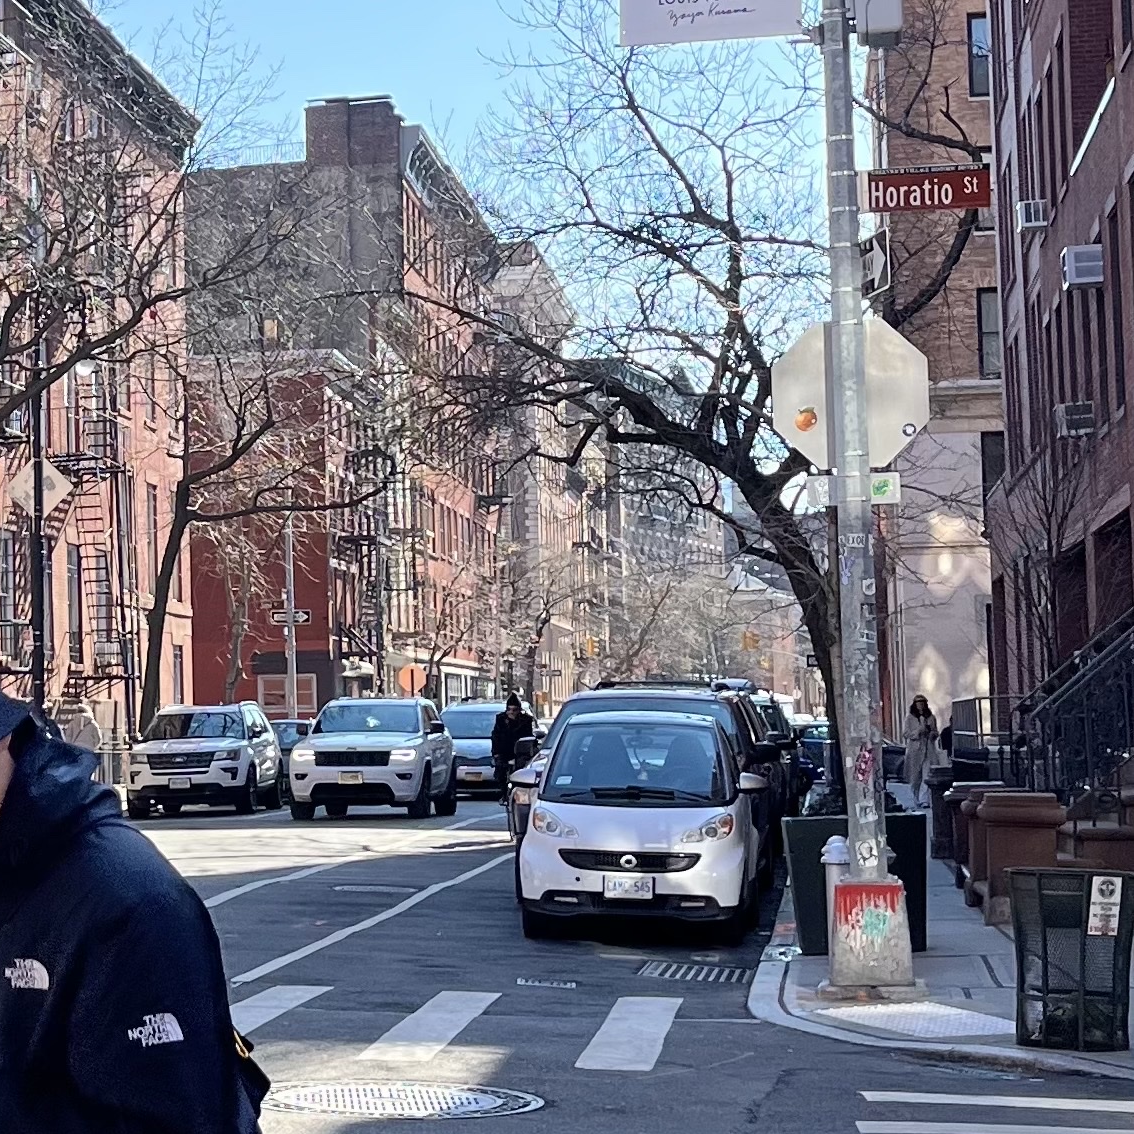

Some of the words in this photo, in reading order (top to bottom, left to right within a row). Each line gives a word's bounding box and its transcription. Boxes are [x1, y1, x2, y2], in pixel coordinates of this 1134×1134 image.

[871, 179, 953, 208] Horatio
[963, 176, 978, 194] St
[143, 1013, 165, 1027] THE
[128, 1024, 167, 1040] NORTH
[142, 1033, 170, 1047] FACE
